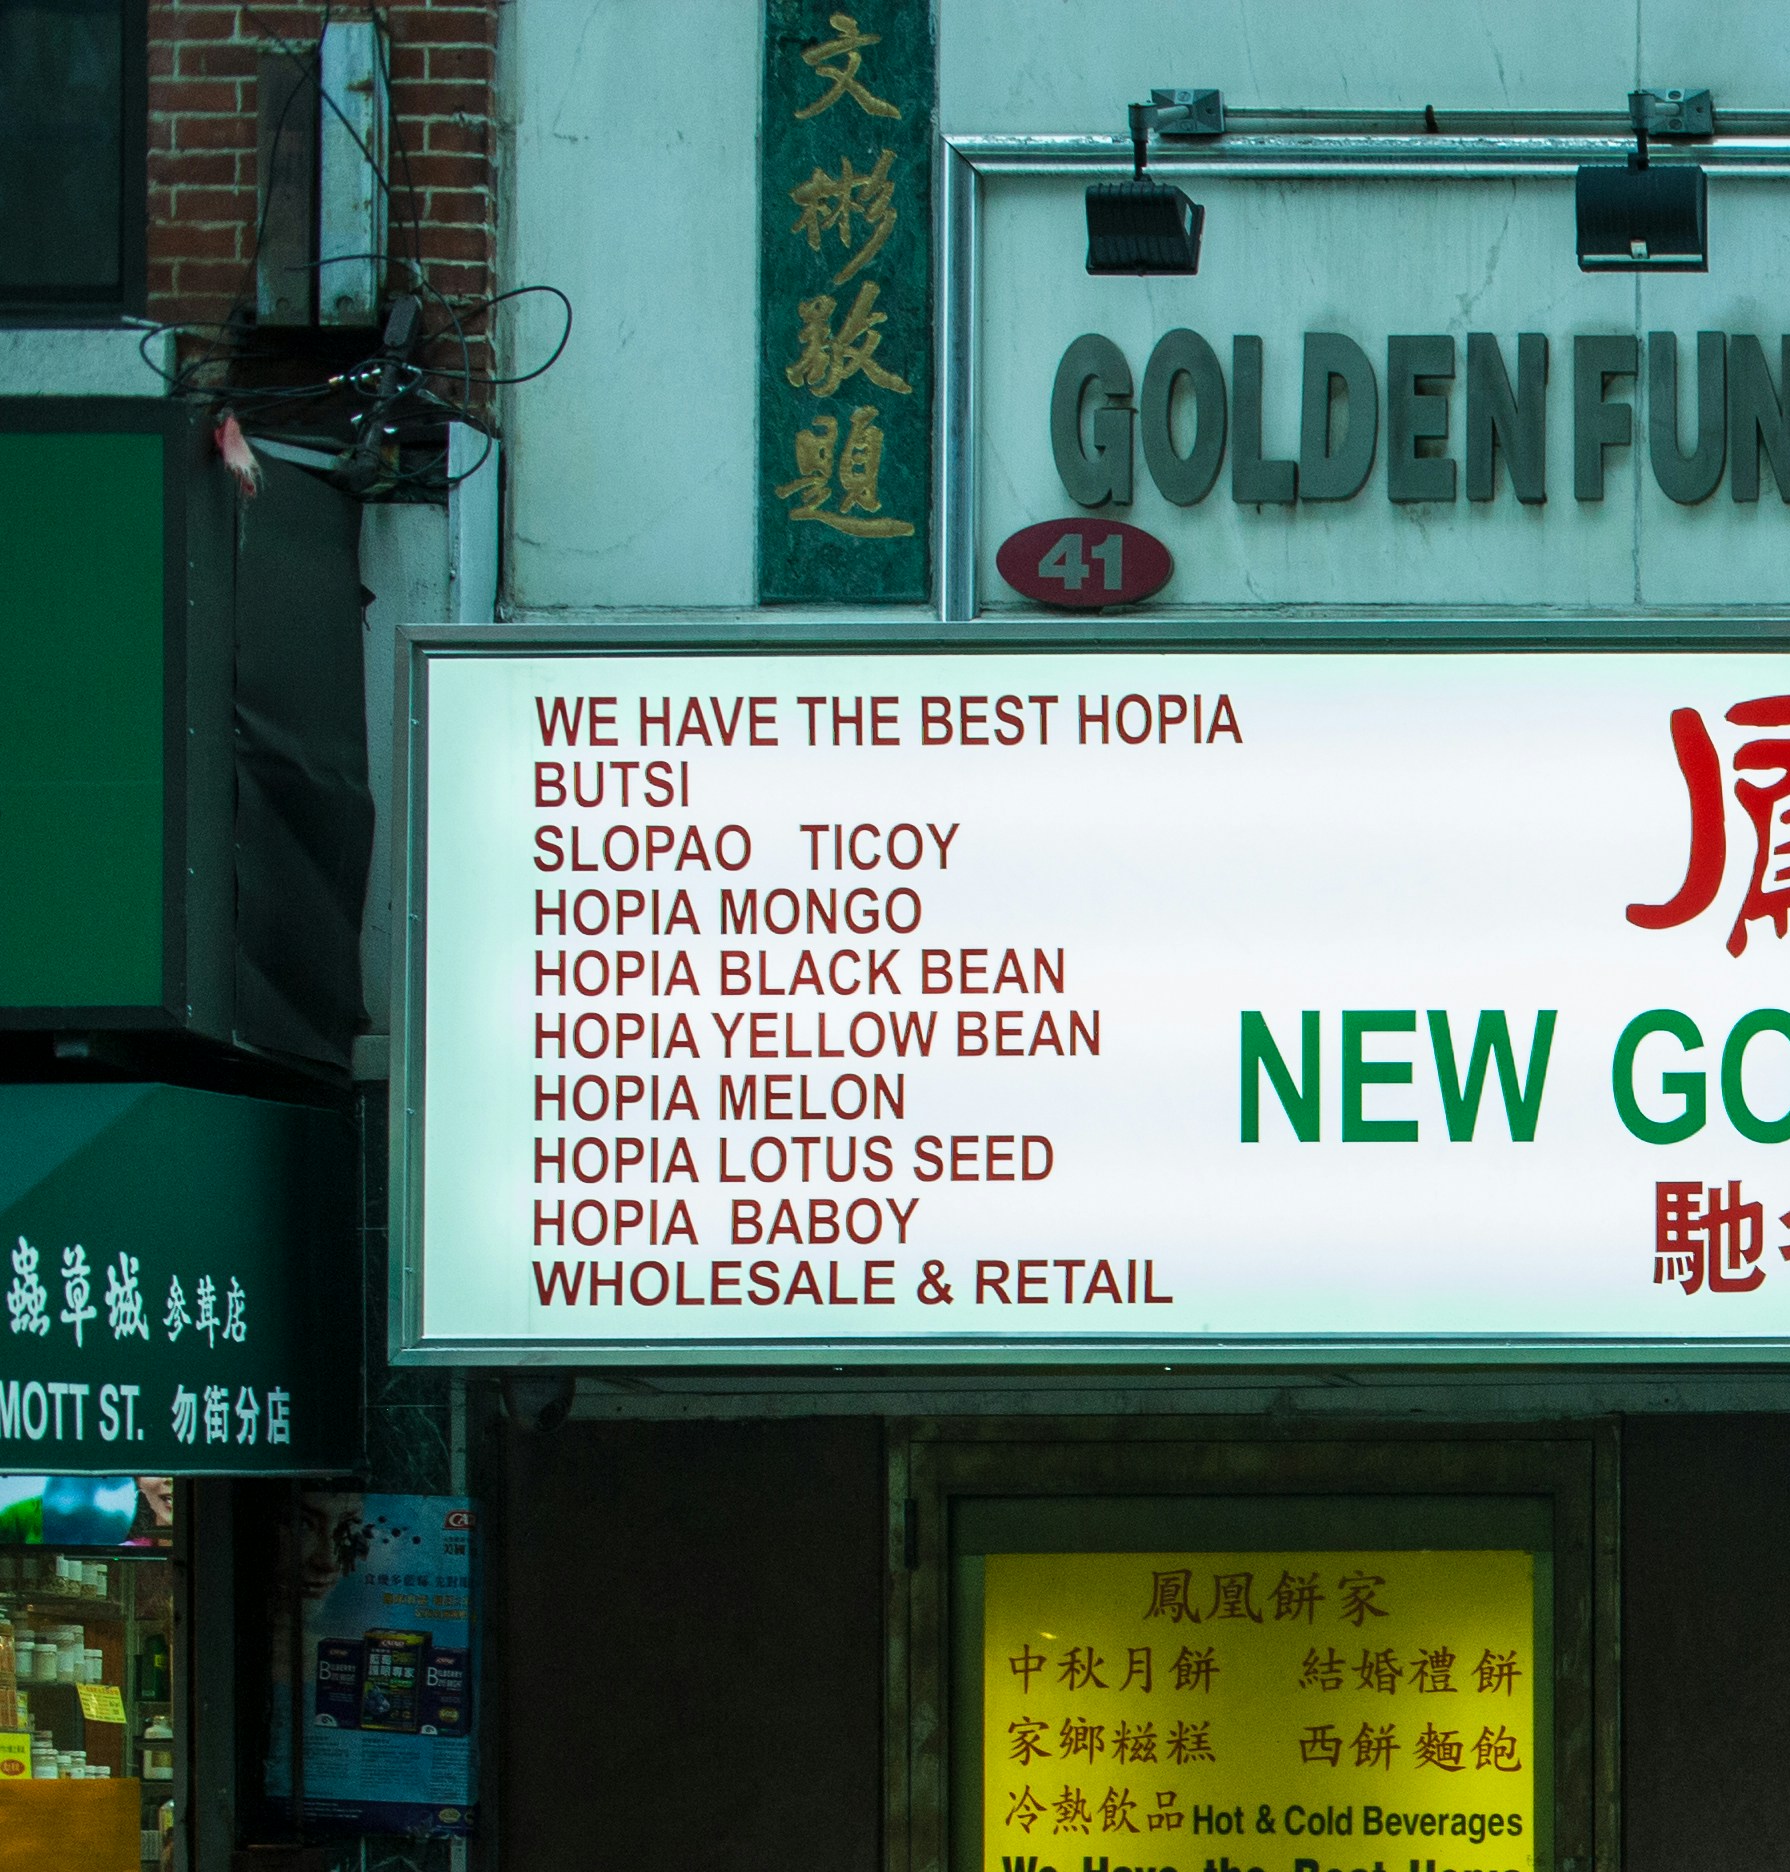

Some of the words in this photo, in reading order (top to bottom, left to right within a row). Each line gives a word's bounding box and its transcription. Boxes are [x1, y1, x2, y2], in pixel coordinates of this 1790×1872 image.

[1050, 329, 1547, 508] GOLDEN
[1039, 534, 1122, 589] 41
[535, 697, 618, 746] WE
[640, 697, 778, 746] HAVE
[797, 696, 899, 746] THE
[922, 695, 1058, 745] BEST
[1079, 694, 1242, 744] HOPIA
[535, 761, 688, 807] BUTSI
[534, 825, 751, 872] SLOPAO
[800, 823, 959, 870] TICOY
[535, 889, 700, 935] HOPIA
[721, 887, 921, 934] MONGO
[535, 950, 699, 996] HOPIA
[721, 949, 901, 995] BLACK
[922, 948, 1063, 994] BEAN
[535, 1013, 700, 1059] HOPIA
[712, 1011, 937, 1058] YELLOW
[958, 1010, 1099, 1056] BEAN
[535, 1075, 699, 1121] HOPIA
[720, 1074, 903, 1120] MELON
[1241, 1010, 1557, 1143] NEW
[534, 1137, 699, 1183] HOPIA
[720, 1136, 893, 1182] LOTUS
[914, 1135, 1053, 1182] SEED
[534, 1199, 698, 1246] HOPIA
[732, 1198, 919, 1244] BABOY
[532, 1261, 895, 1306] WHOLESALE
[917, 1260, 953, 1304] &
[976, 1260, 1173, 1304] RETAIL
[0, 1380, 89, 1441] MOTT
[100, 1383, 144, 1442] ST.
[171, 1384, 291, 1446] 勿街分店
[1144, 1568, 1393, 1627] 鳳凰餅家
[1009, 1644, 1221, 1695] 中秋月餅
[1298, 1645, 1523, 1698] 結婚禮餅
[1005, 1784, 1185, 1837] 冷熱飲品
[1193, 1805, 1245, 1836] Hot
[1257, 1806, 1275, 1834] &
[1284, 1806, 1353, 1836] Cold
[1362, 1806, 1523, 1844] Beverages
